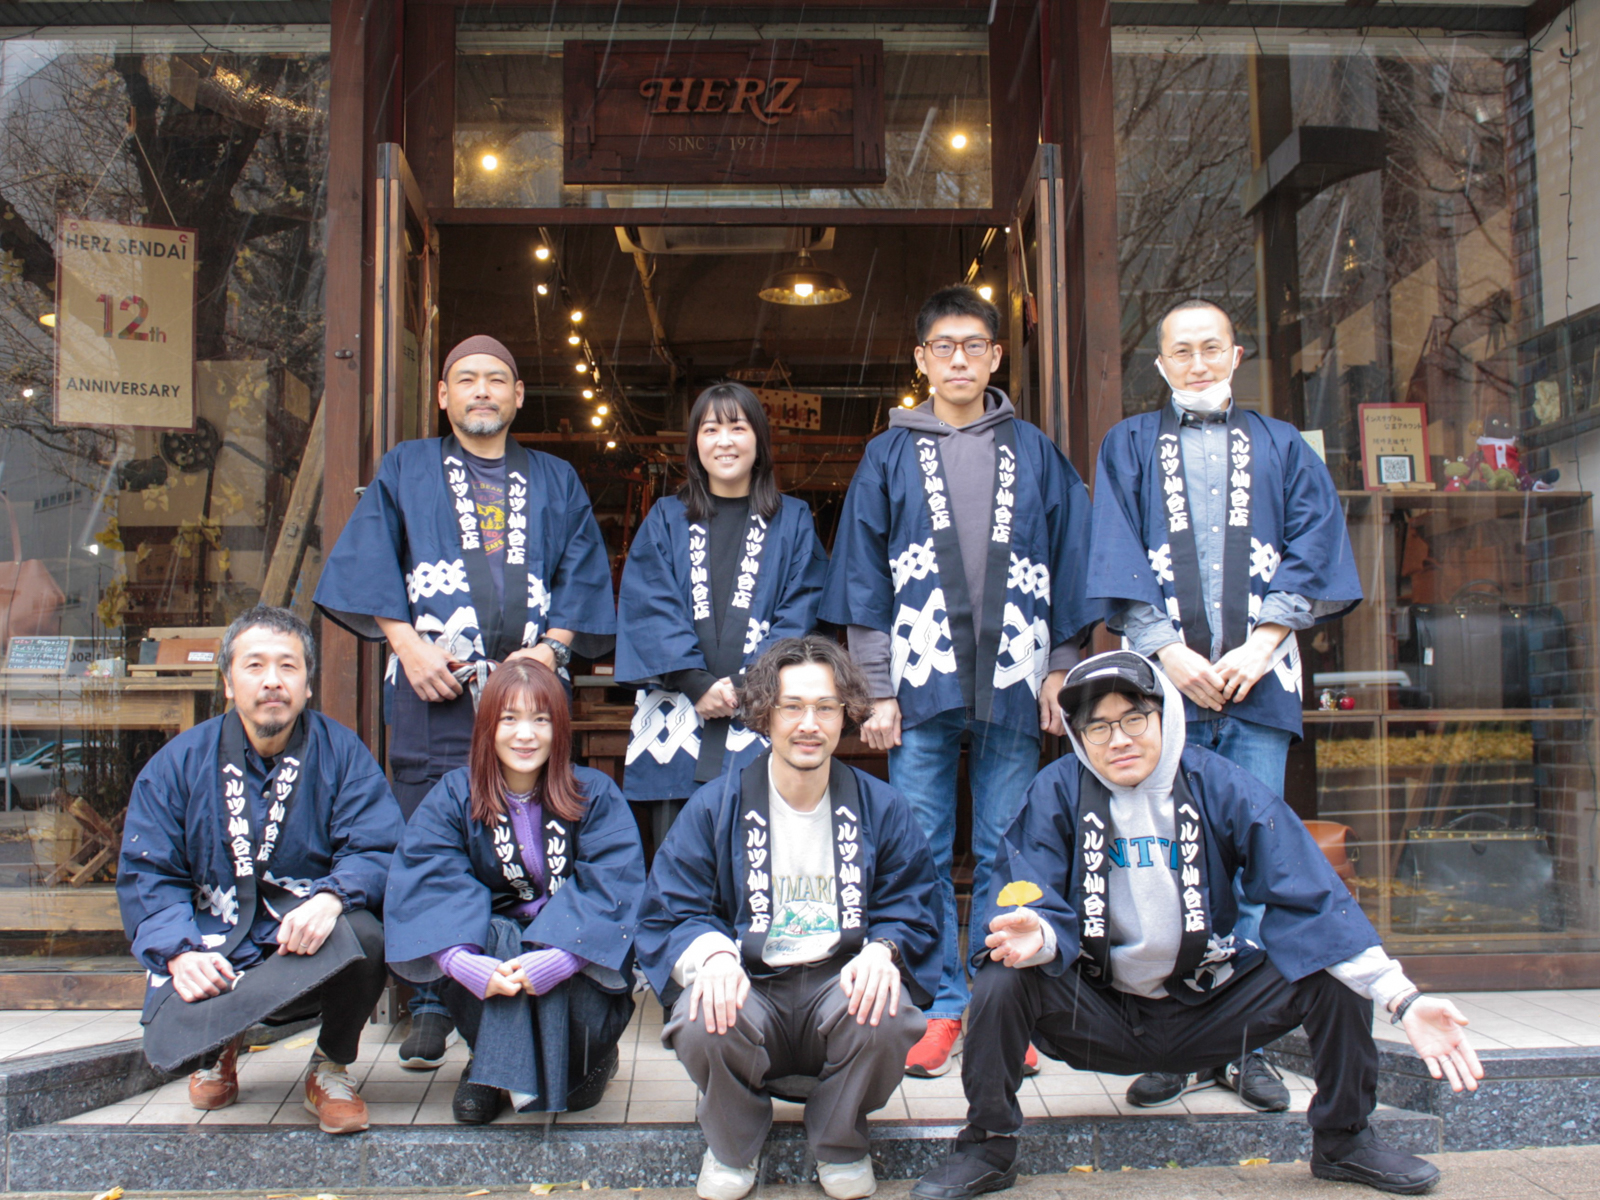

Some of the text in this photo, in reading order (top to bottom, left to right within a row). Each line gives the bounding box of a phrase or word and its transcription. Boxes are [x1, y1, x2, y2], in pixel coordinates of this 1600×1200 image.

[639, 77, 802, 124] HERZ
[668, 136, 715, 150] SINCE
[65, 234, 187, 260] HERZ SENDAI
[96, 294, 167, 343] 12th
[66, 377, 181, 398] ANNIVERSARY
[443, 456, 480, 550] ヘルツ仙台店
[506, 471, 528, 565] ヘルツ仙台店
[916, 437, 951, 531] ヘルツ仙台店
[991, 445, 1016, 543] ヘルツ仙台店
[1159, 434, 1189, 533] ヘルツ仙台店
[1230, 428, 1251, 527] ヘルツ仙台店
[688, 523, 710, 620] ヘルツ仙台店
[731, 514, 767, 609] ヘルツ仙台店
[223, 763, 253, 877] ヘルツ仙台店
[257, 757, 300, 861] ヘルツ仙台店
[745, 810, 770, 933] ヘルツ仙台店
[835, 806, 862, 929] ヘルツ仙台店
[1083, 812, 1105, 937] ヘルツ仙台店
[1178, 803, 1205, 932] ヘルツ仙台店
